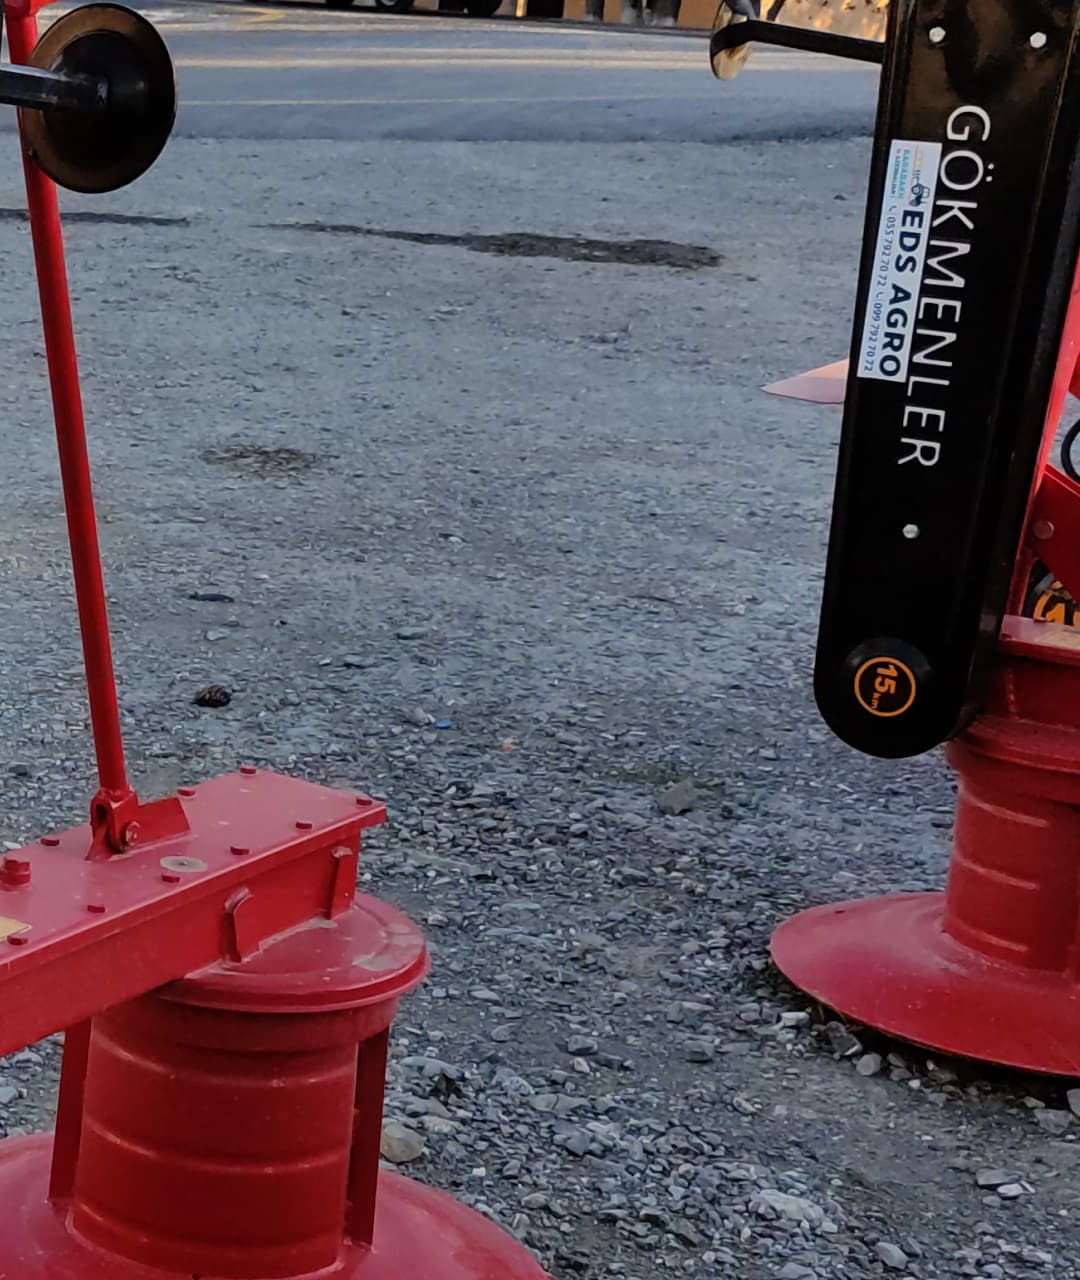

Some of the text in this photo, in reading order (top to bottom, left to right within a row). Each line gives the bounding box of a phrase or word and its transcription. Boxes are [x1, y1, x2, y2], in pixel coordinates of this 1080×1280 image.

[877, 217, 896, 287] 055 792 70 72
[897, 104, 995, 467] GÖKMENLER
[878, 209, 925, 377] EDS AGRO
[864, 302, 882, 372] 099 792 70 72
[874, 664, 899, 694] 15
